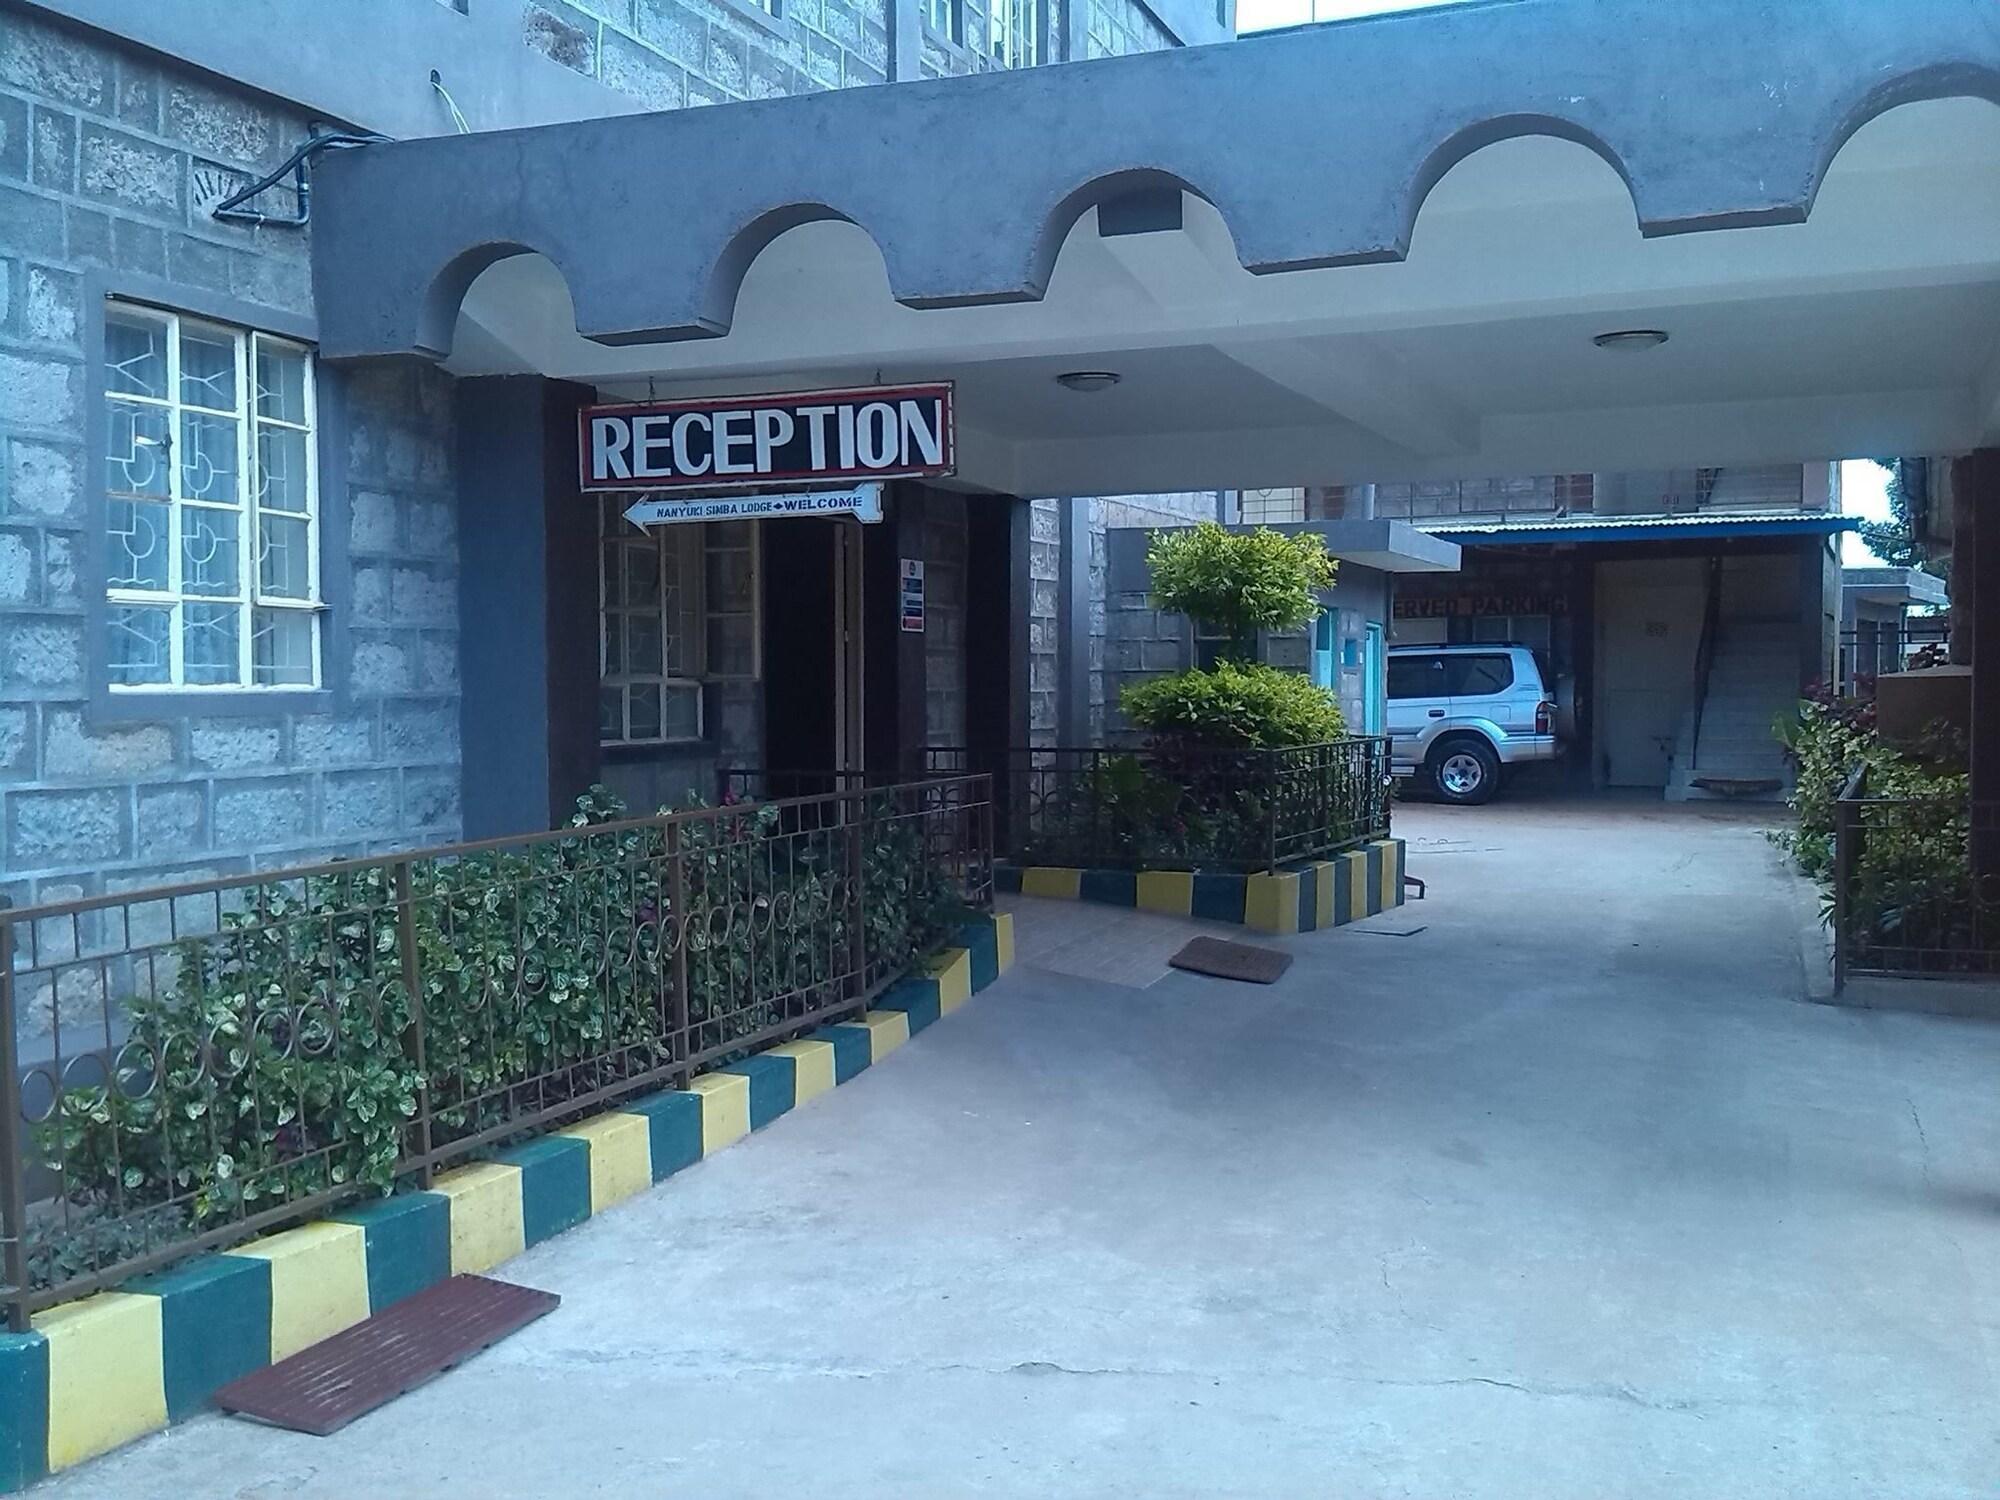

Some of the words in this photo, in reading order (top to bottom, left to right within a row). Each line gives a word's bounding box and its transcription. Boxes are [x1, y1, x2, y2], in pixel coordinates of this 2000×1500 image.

[591, 399, 944, 480] RECEPTION
[656, 506, 703, 518] NANYUKI
[706, 504, 738, 516] SIMBA
[741, 502, 773, 514] LODGE
[784, 496, 863, 511] WELCOME
[1472, 595, 1568, 616] PARKING
